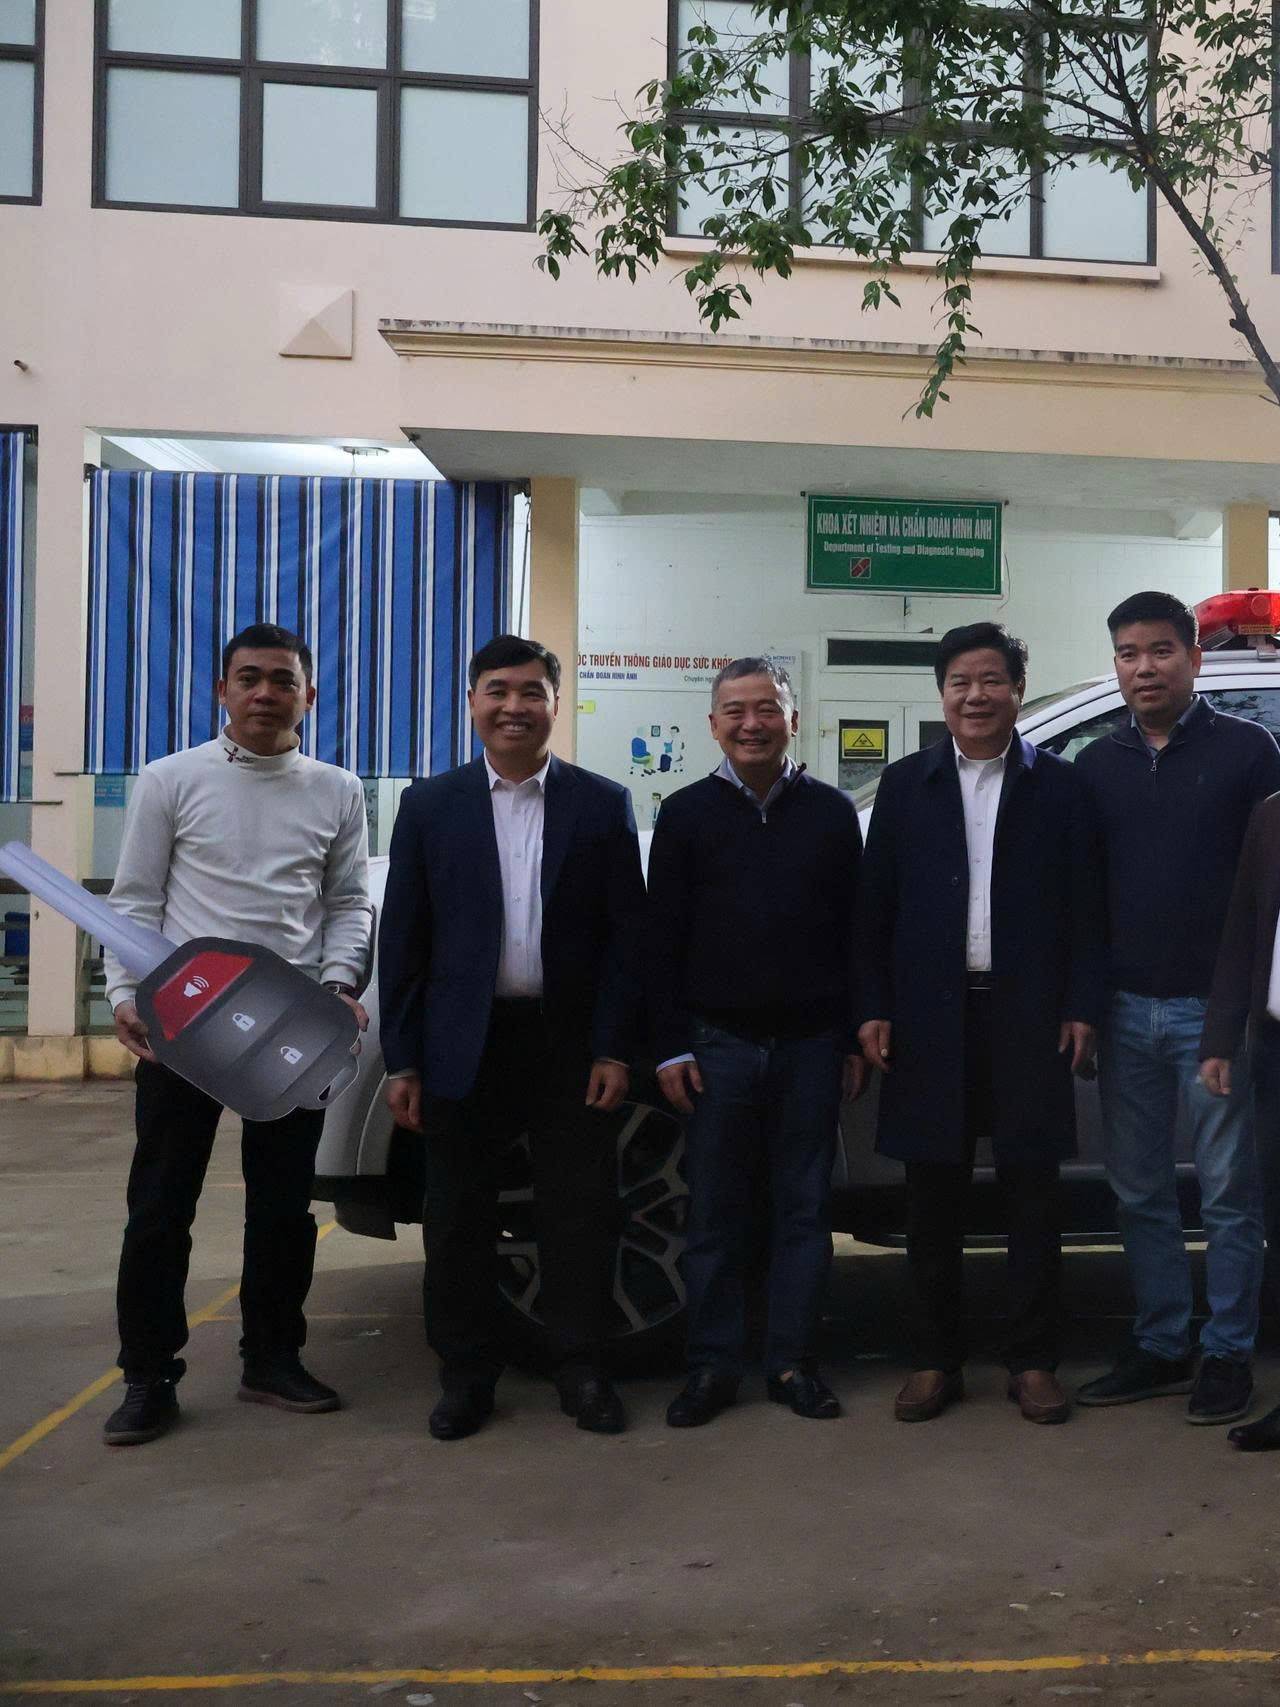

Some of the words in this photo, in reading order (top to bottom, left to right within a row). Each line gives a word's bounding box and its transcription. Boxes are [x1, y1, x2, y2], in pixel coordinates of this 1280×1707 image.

[816, 512, 840, 534] KHOA
[841, 510, 857, 535] XÉT
[824, 541, 865, 553] Department
[866, 543, 874, 554] of
[875, 543, 901, 556] Testing
[902, 545, 916, 555] and
[917, 545, 955, 557] Diagnostic
[956, 546, 985, 559] Imaging
[652, 653, 672, 669] GIÁO
[674, 656, 691, 671] DỤC
